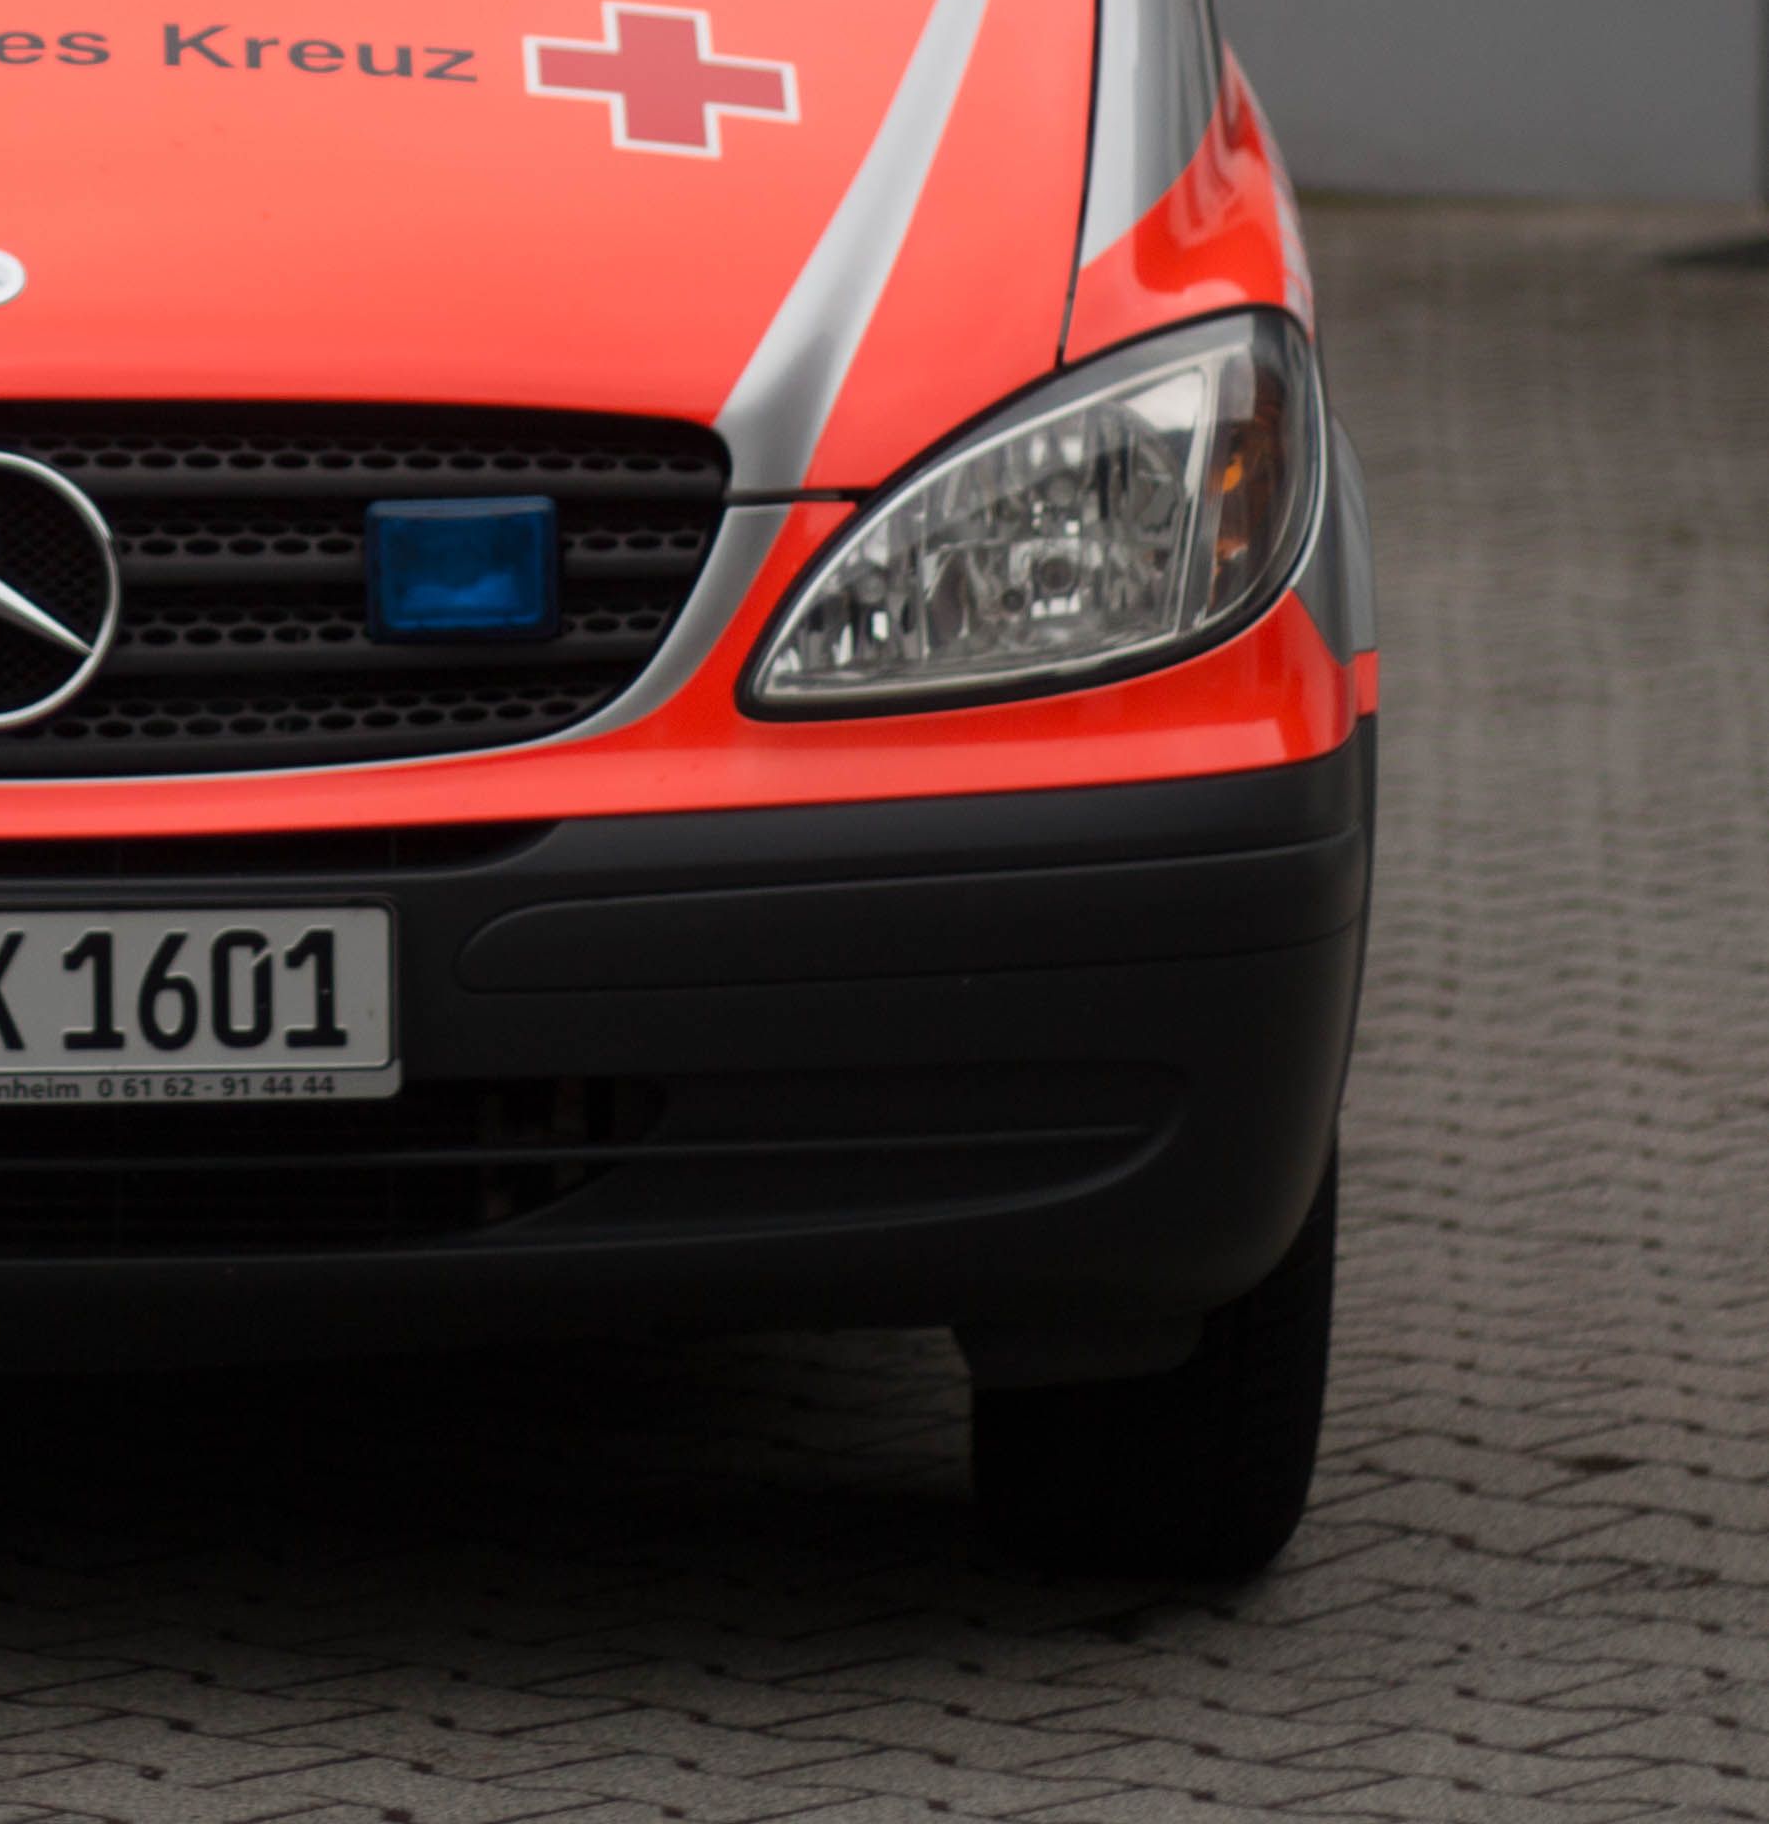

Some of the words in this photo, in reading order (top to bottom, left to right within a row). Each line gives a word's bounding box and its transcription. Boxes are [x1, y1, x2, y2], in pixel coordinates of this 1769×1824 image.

[163, 23, 478, 82] Kreuz
[63, 929, 348, 1050] 1601
[123, 1076, 152, 1098] 61
[163, 1076, 195, 1098] 62
[222, 1076, 251, 1097] 91
[261, 1075, 294, 1097] 44
[302, 1074, 336, 1096] 44
